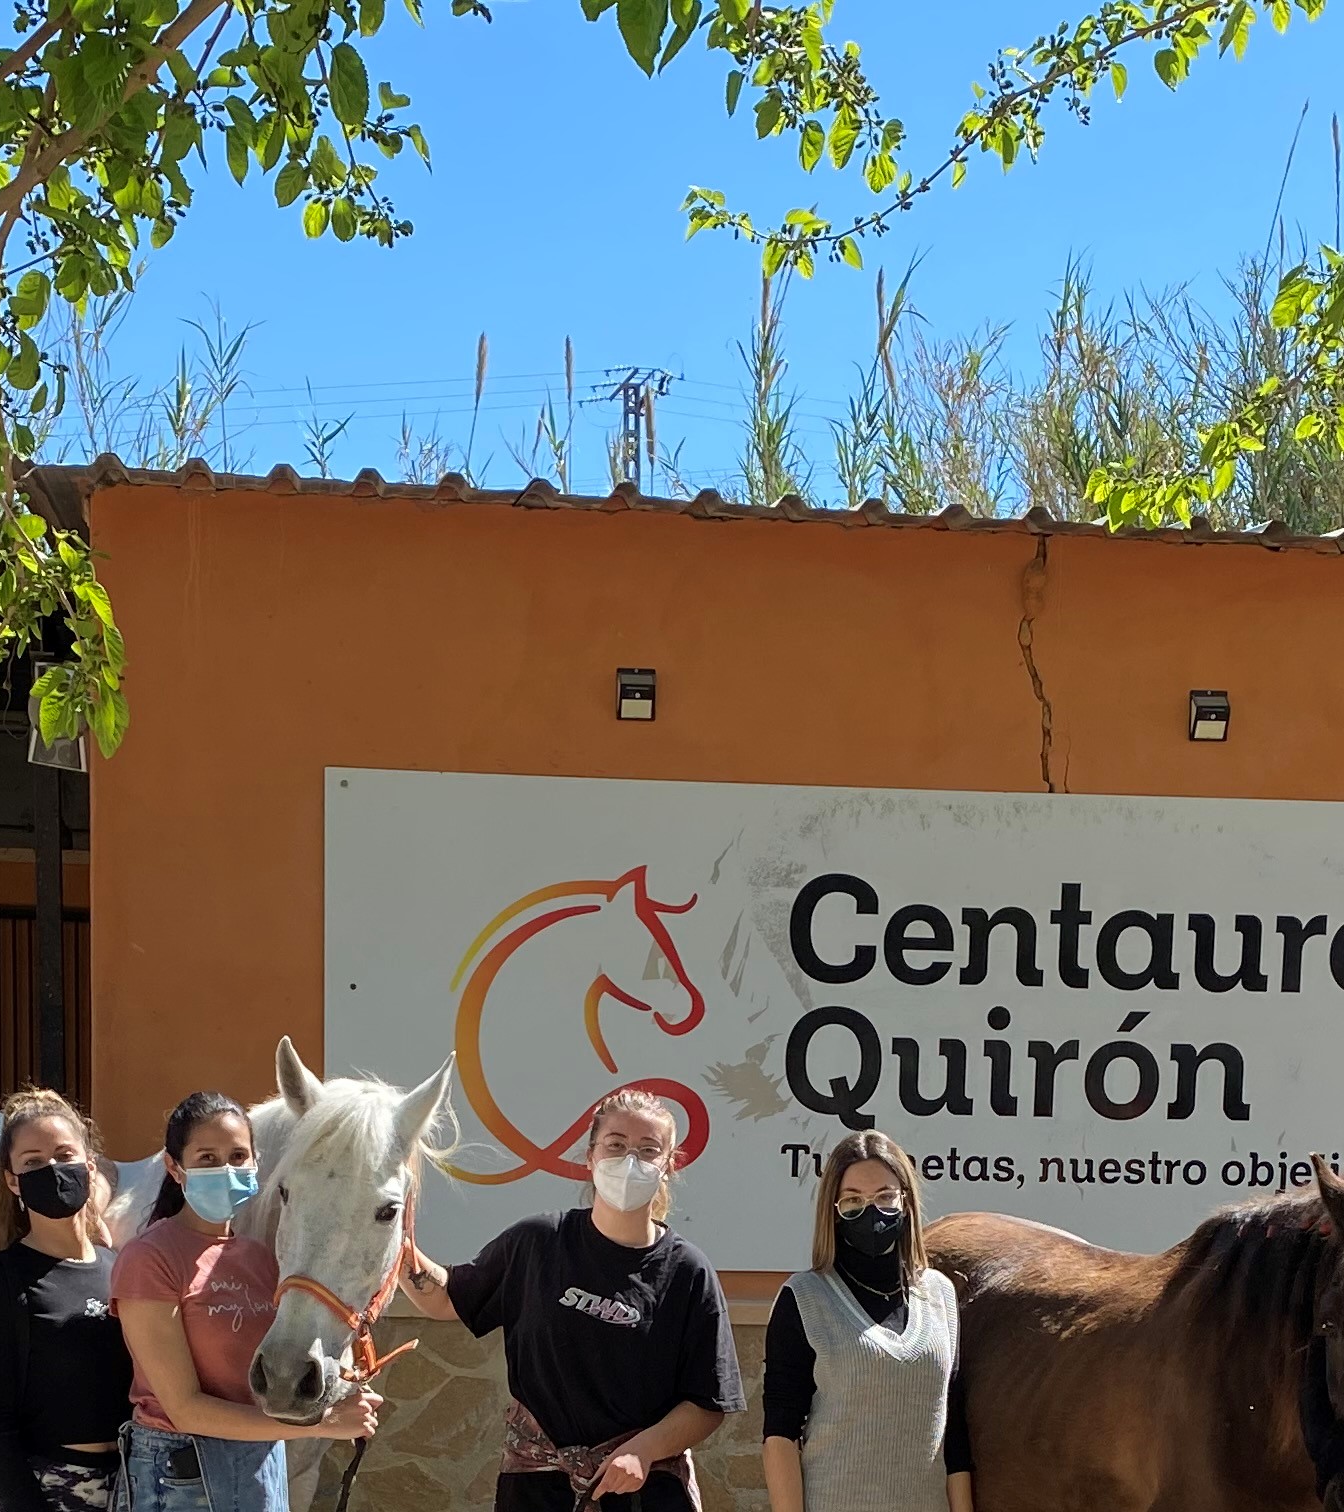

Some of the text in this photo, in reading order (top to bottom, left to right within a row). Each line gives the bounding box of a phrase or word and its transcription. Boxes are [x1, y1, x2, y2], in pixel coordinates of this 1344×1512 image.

[785, 1005, 1251, 1131] Quirón
[906, 1147, 1025, 1190] etas,
[1039, 1151, 1207, 1186] nuestro
